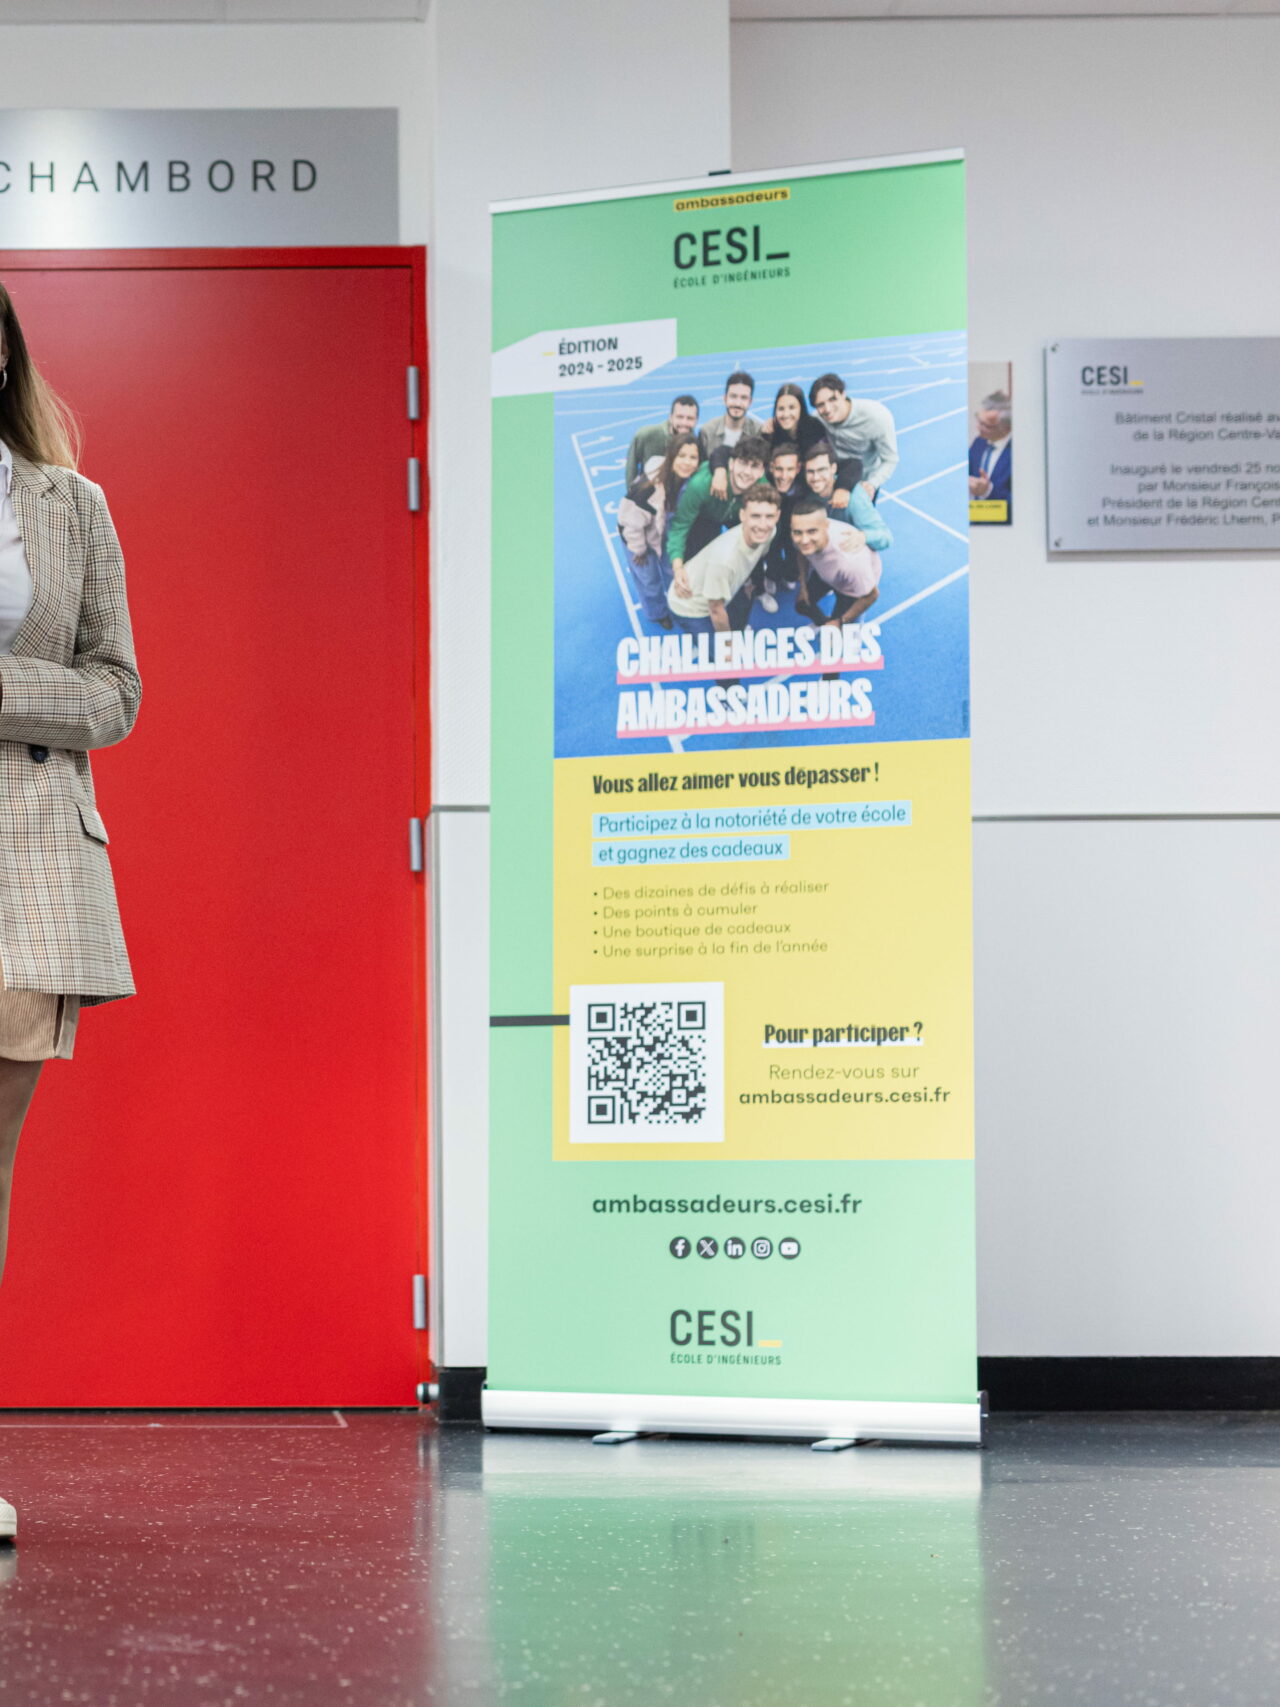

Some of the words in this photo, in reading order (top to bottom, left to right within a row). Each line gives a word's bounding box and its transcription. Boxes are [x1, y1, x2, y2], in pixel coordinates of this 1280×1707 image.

[675, 189, 789, 211] ambassadeurs
[673, 275, 707, 288] ÉCOLE
[712, 267, 790, 285] D'INGÉNIEURS
[558, 337, 619, 356] ÉDITION
[558, 361, 594, 377] 2024
[607, 356, 643, 373] 2025
[1115, 411, 1173, 425] Bâtiment
[1176, 410, 1217, 424] Cristal
[1221, 410, 1263, 424] réalisé
[1133, 429, 1149, 441] de
[1153, 429, 1165, 441] la
[1168, 428, 1214, 443] Région
[1110, 463, 1167, 478] Inauguré
[1171, 462, 1183, 474] le
[1186, 462, 1241, 474] vendredi
[1245, 461, 1261, 475] 25
[1138, 481, 1158, 494] par
[1163, 479, 1221, 492] Monsieur
[1102, 496, 1162, 509] Président
[1167, 496, 1183, 509] de
[1187, 496, 1198, 509] la
[1202, 495, 1248, 511] Région
[1087, 515, 1099, 526] et
[1103, 514, 1162, 526] Monsieur
[1166, 513, 1218, 526] Frédéric
[616, 625, 816, 677] CHALLENGES
[819, 622, 882, 666] DES
[616, 677, 872, 733] AMBASSADEURS
[593, 775, 634, 795] Vous
[637, 772, 678, 793] allez
[681, 772, 734, 791] aimer
[738, 770, 781, 788] vous
[784, 766, 870, 789] dépasser
[599, 814, 677, 835] Participez
[681, 812, 692, 830] à
[695, 812, 711, 830] la
[714, 808, 787, 829] notoriété
[791, 808, 812, 826] de
[815, 807, 857, 824] votre
[861, 804, 907, 823] école
[599, 846, 614, 862] et
[616, 846, 677, 865] gagnez
[679, 841, 709, 859] des
[711, 839, 783, 858] cadeaux
[602, 886, 631, 900] Des
[634, 884, 694, 900] dizaines
[698, 883, 716, 897] de
[720, 881, 756, 897] défis
[760, 881, 770, 895] à
[775, 879, 829, 894] réaliser
[602, 905, 631, 919] Des
[635, 904, 680, 921] points
[683, 902, 693, 917] à
[697, 901, 758, 916] cumuler
[602, 925, 631, 938] Une
[635, 923, 700, 938] boutique
[704, 922, 722, 936] de
[727, 920, 791, 935] cadeaux
[602, 944, 631, 958] Une
[635, 942, 694, 959] surprise
[698, 942, 708, 956] à
[712, 941, 725, 955] la
[730, 940, 749, 955] fin
[753, 940, 772, 955] de
[776, 937, 829, 953] l'année
[764, 1023, 809, 1044] Pour
[812, 1023, 910, 1047] participer
[769, 1063, 886, 1080] Rendez-vous
[891, 1064, 920, 1080] sur
[738, 1086, 952, 1105] ambassadeurs.cesi.fr
[592, 1193, 863, 1214] ambassadeurs.cesi.fr
[669, 1351, 703, 1364] ÉCOLE
[706, 1352, 783, 1366] D'INGÉNIEURS
